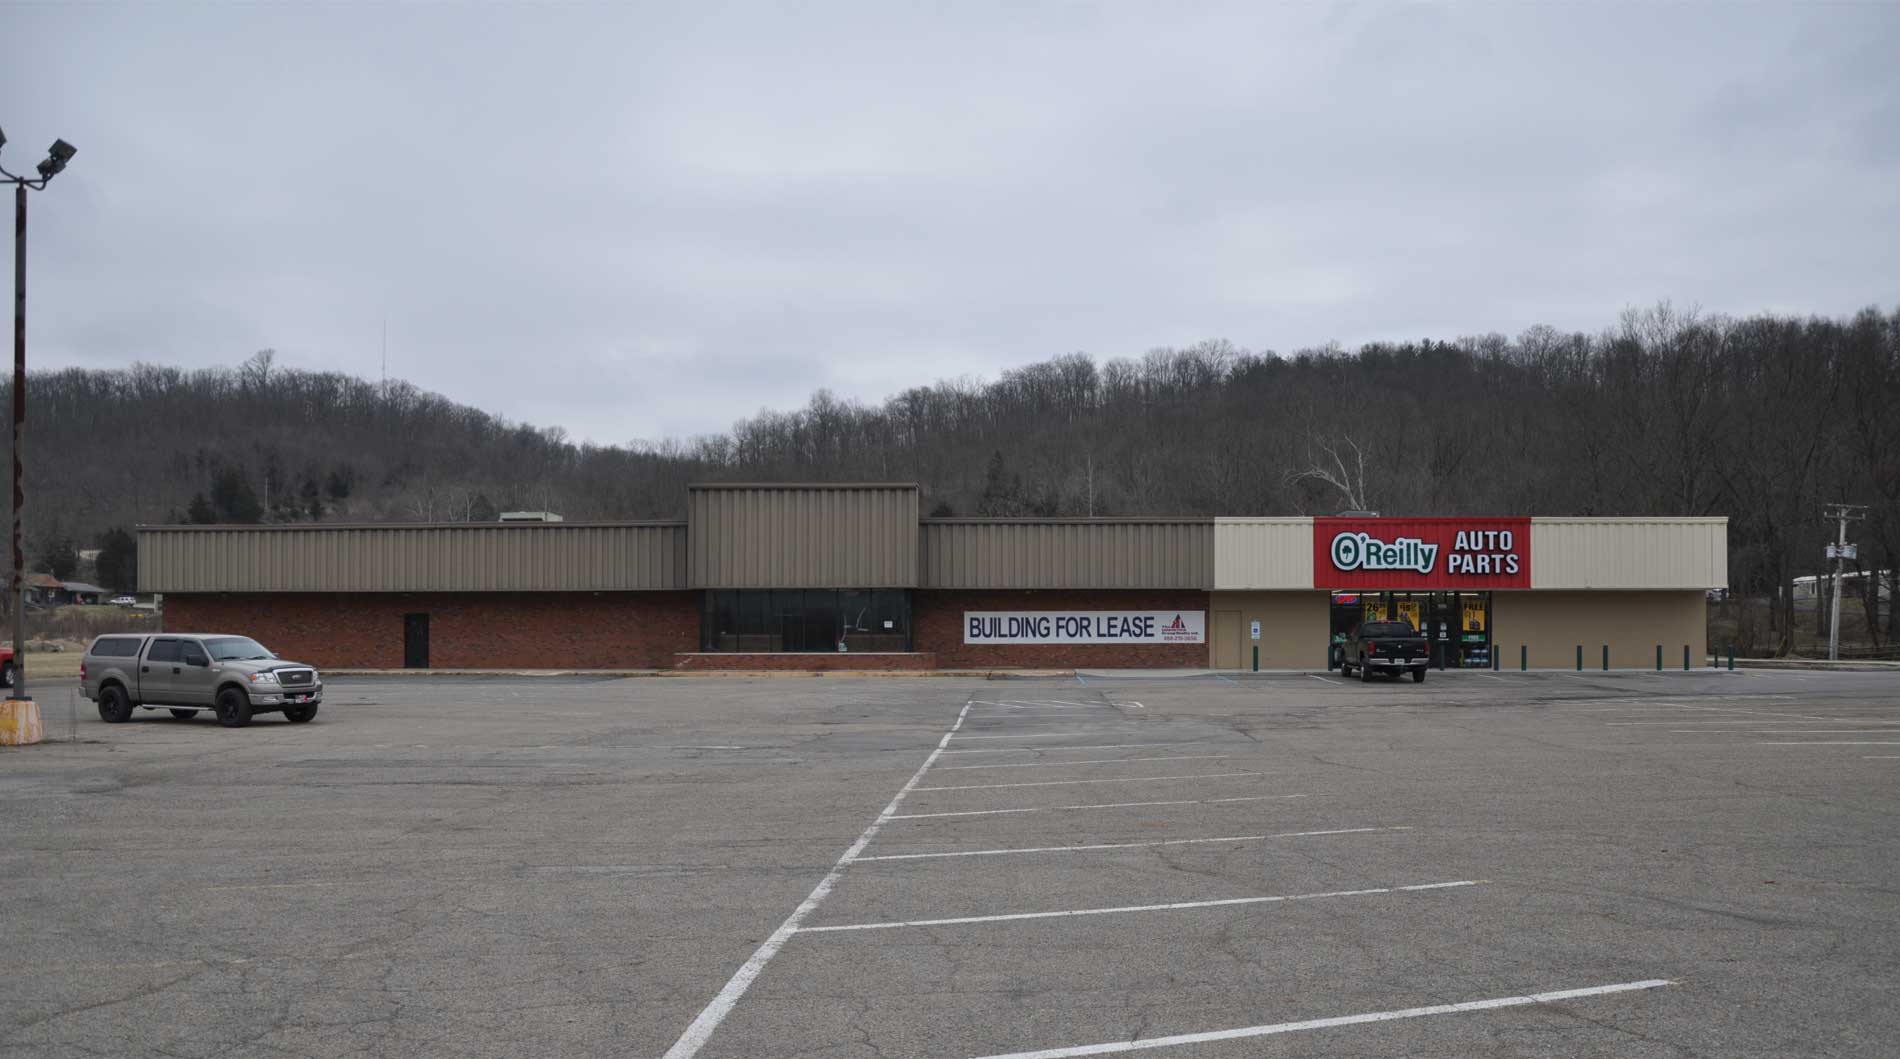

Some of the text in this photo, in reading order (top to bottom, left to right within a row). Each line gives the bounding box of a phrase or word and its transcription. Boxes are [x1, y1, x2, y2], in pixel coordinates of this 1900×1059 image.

[1455, 531, 1512, 550] AUTO
[1333, 533, 1437, 572] O'Reilly
[1448, 554, 1519, 573] PARTS
[969, 615, 1155, 638] BUILDING FOR LEASE
